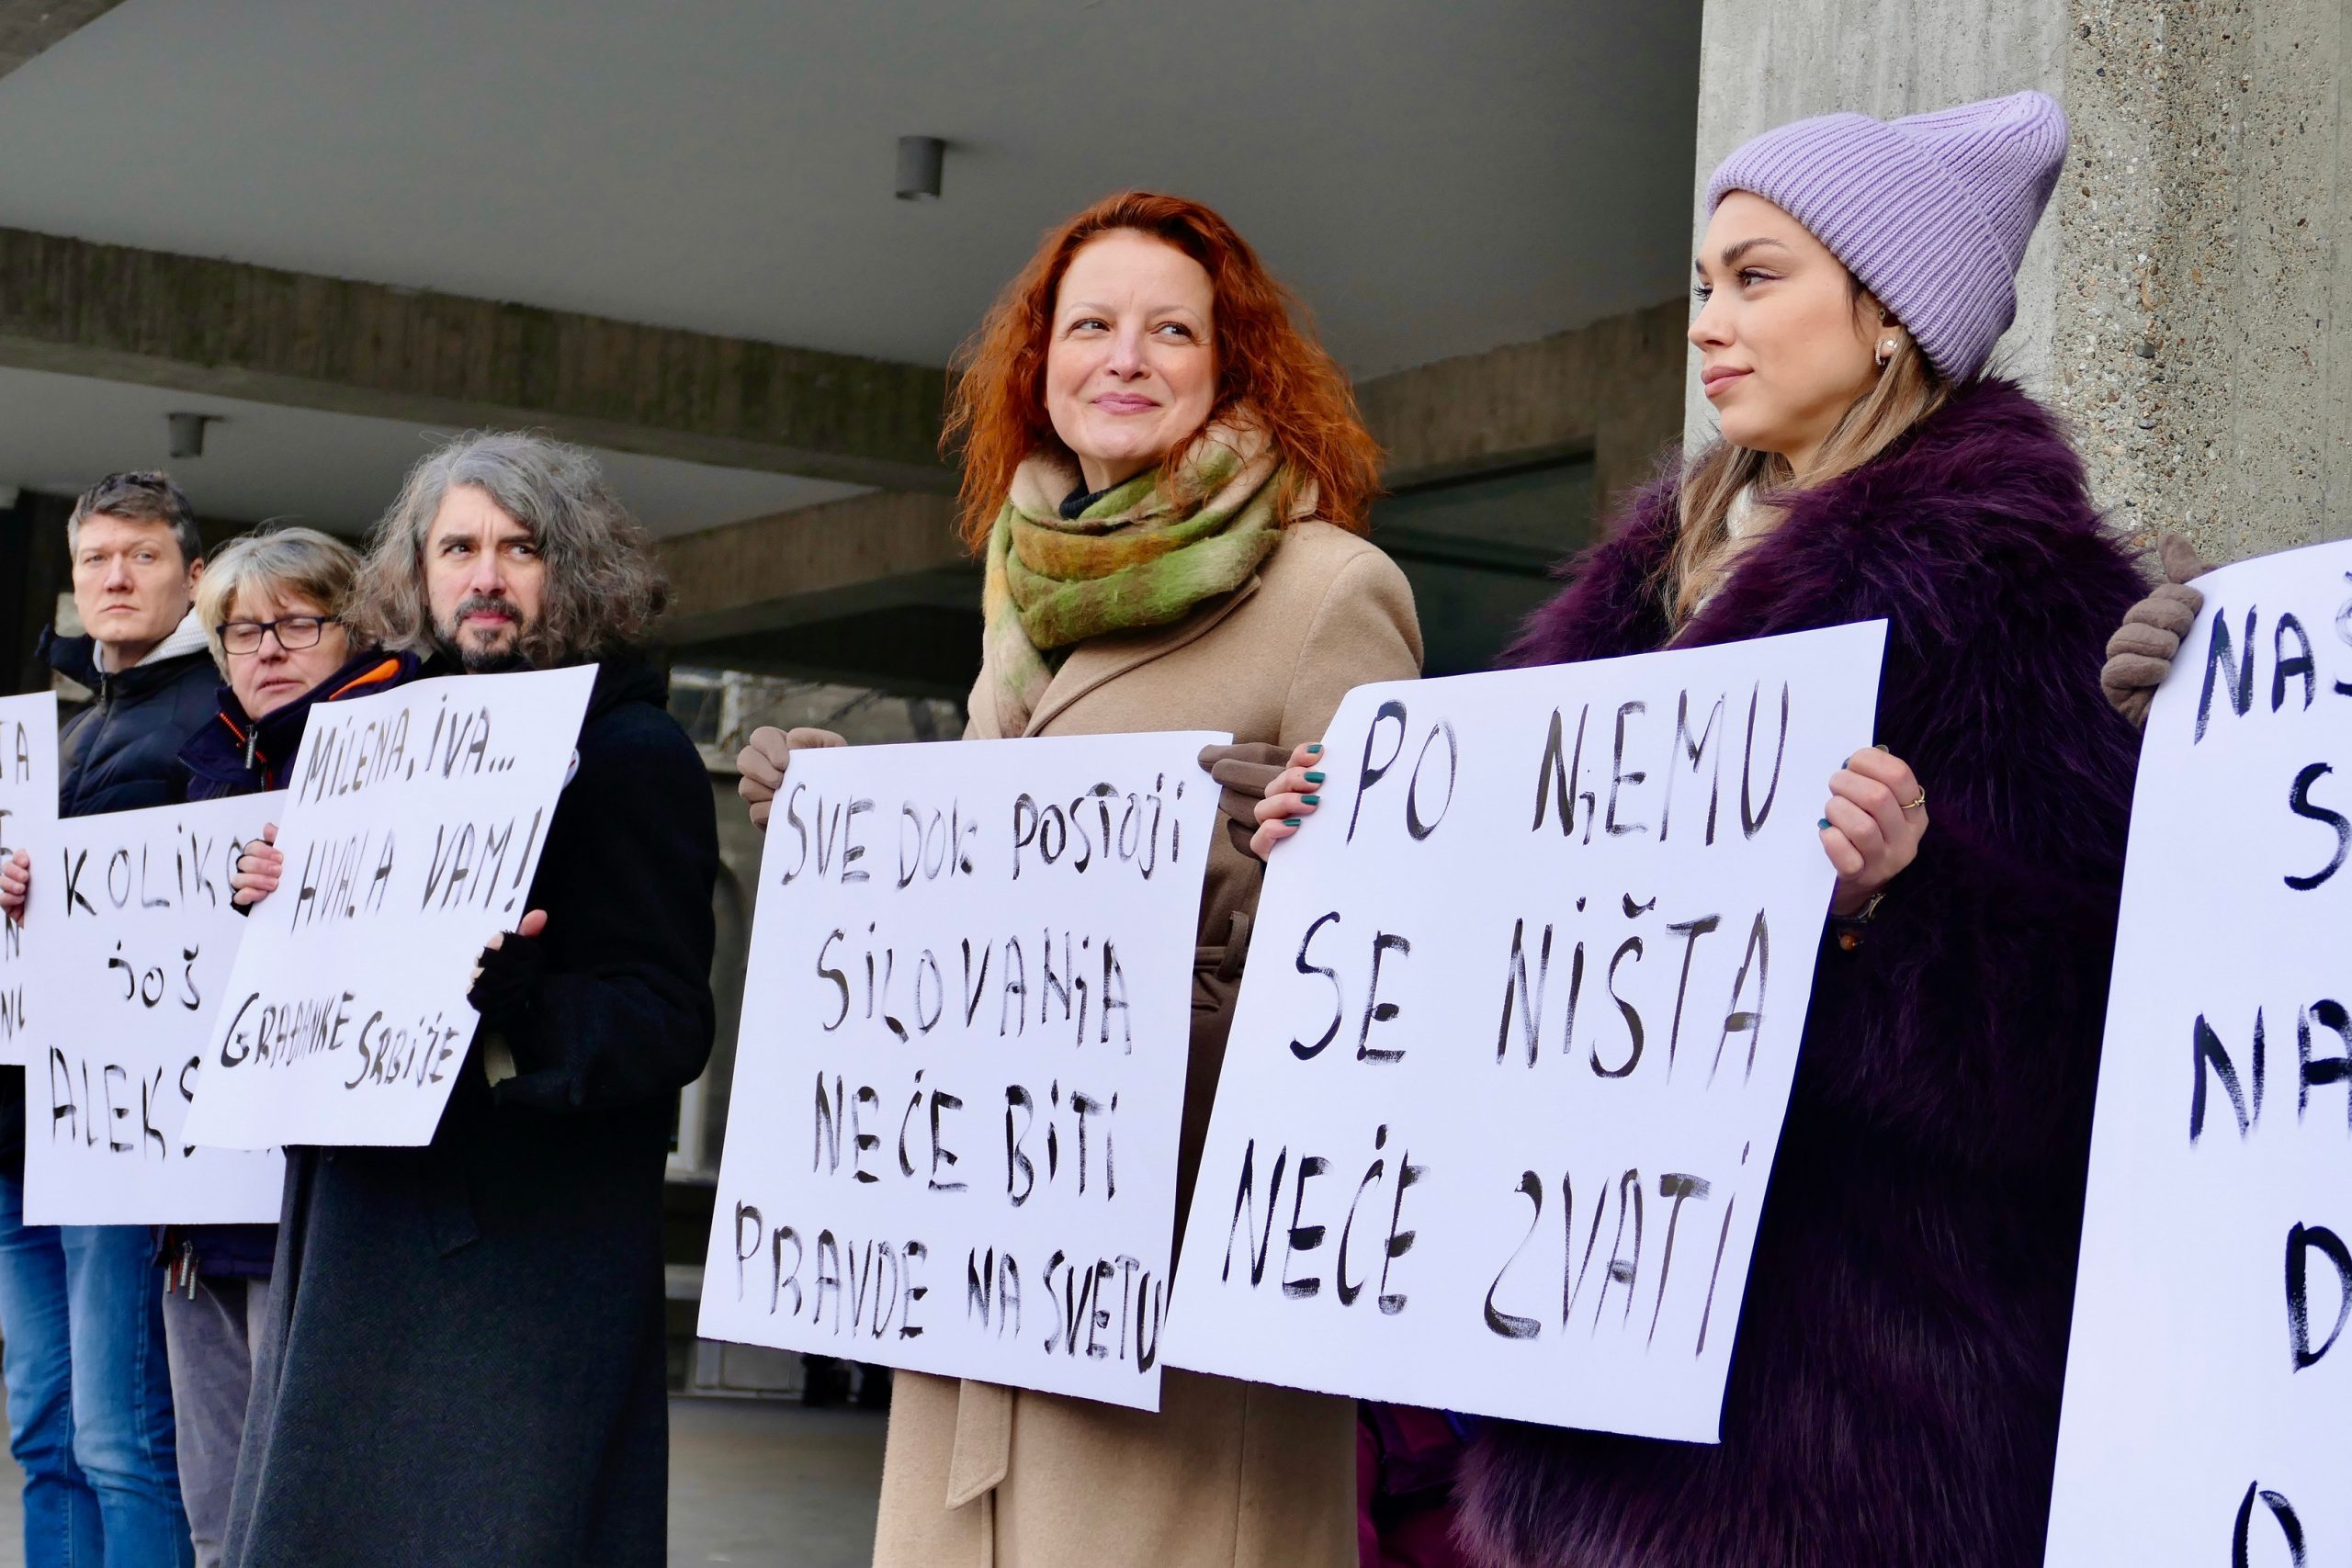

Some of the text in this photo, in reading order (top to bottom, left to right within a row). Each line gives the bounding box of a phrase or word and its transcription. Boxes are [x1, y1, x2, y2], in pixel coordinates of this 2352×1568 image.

[780, 782, 876, 886] SVE
[896, 796, 978, 890] DOK
[1347, 699, 1458, 845] PO
[420, 805, 544, 915] VAM!
[1290, 911, 1410, 1065] SE
[814, 1068, 969, 1193] NEĆE
[735, 1199, 1162, 1374] PRAVDE NA SVETU
[1221, 1122, 1431, 1316] NEĆE
